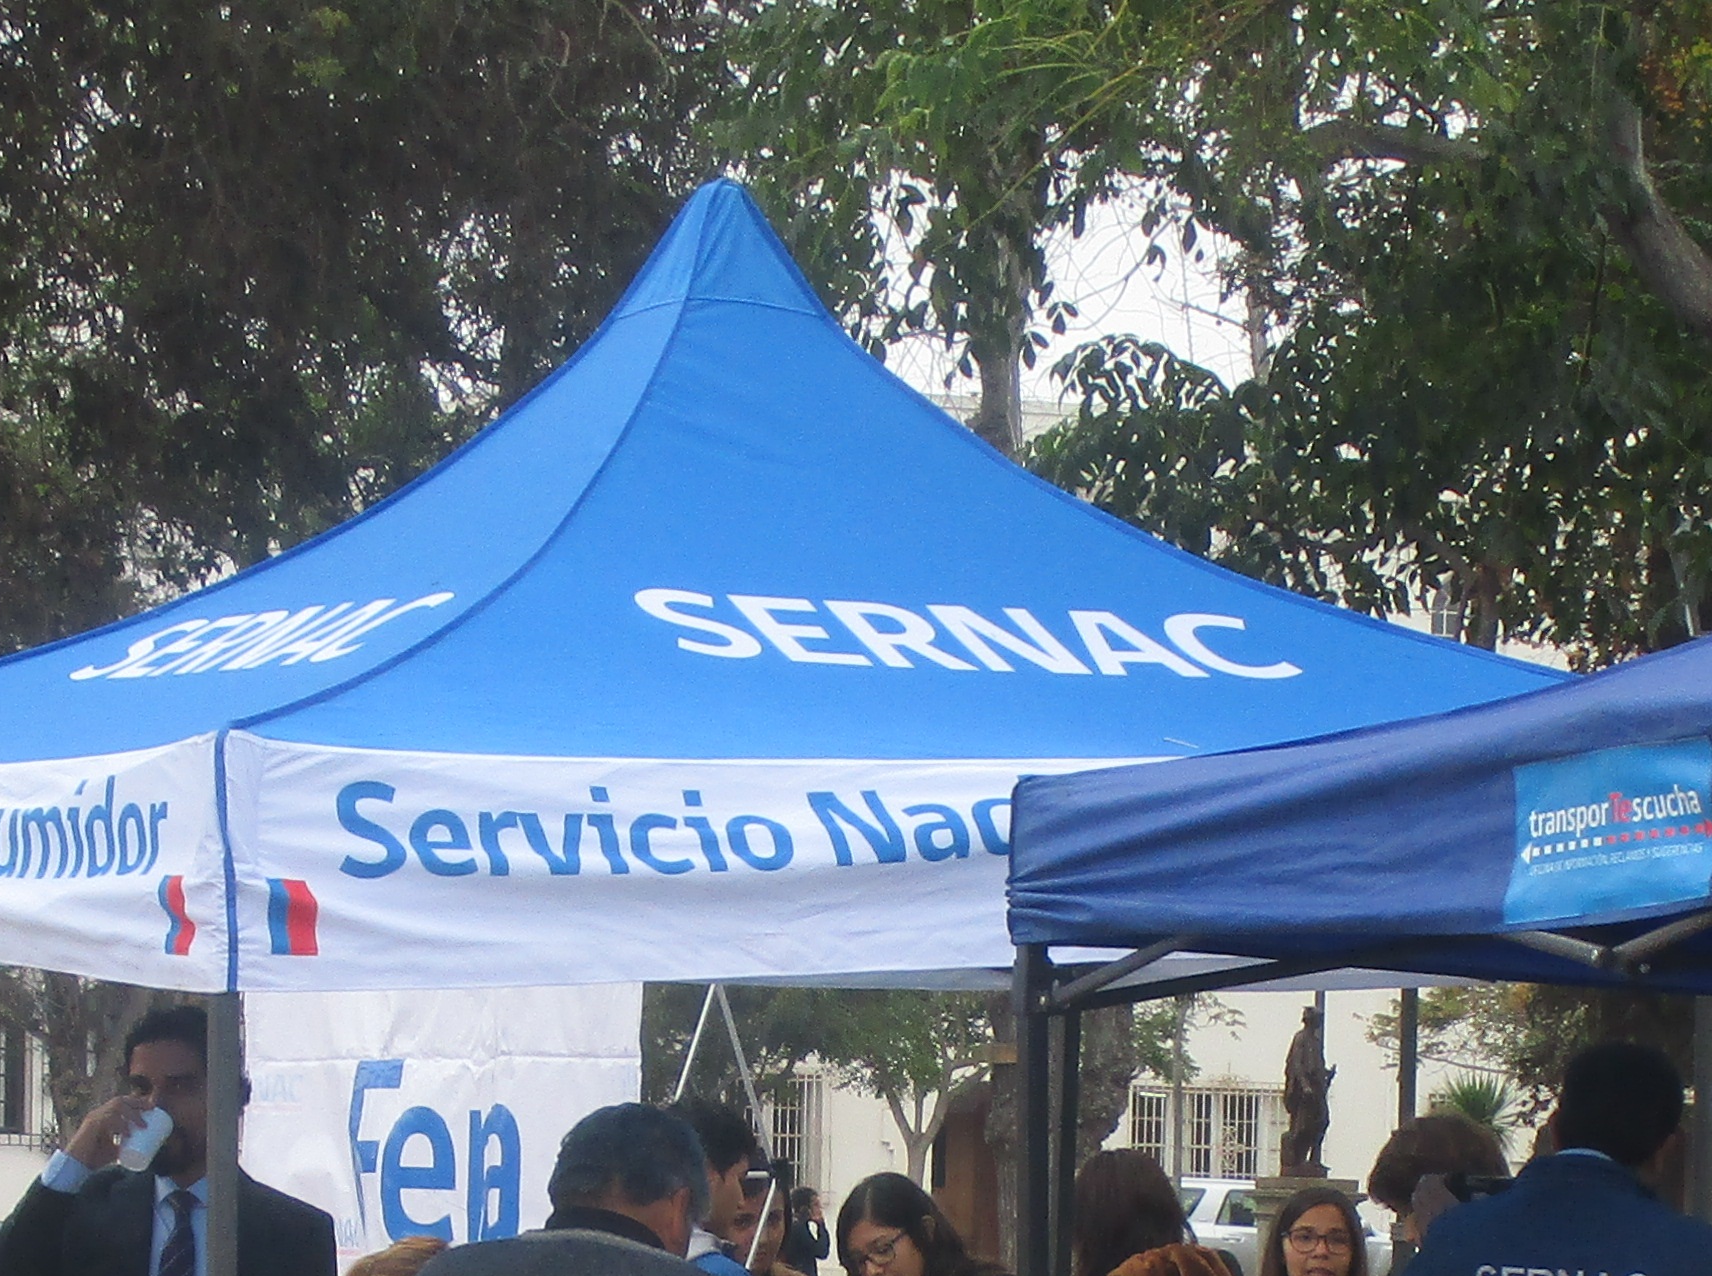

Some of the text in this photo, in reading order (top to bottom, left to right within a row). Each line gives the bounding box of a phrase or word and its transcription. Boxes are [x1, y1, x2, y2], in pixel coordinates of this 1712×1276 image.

[69, 591, 456, 681] SERNAC
[633, 587, 1304, 680] SERNAC
[335, 779, 795, 880] Servicio
